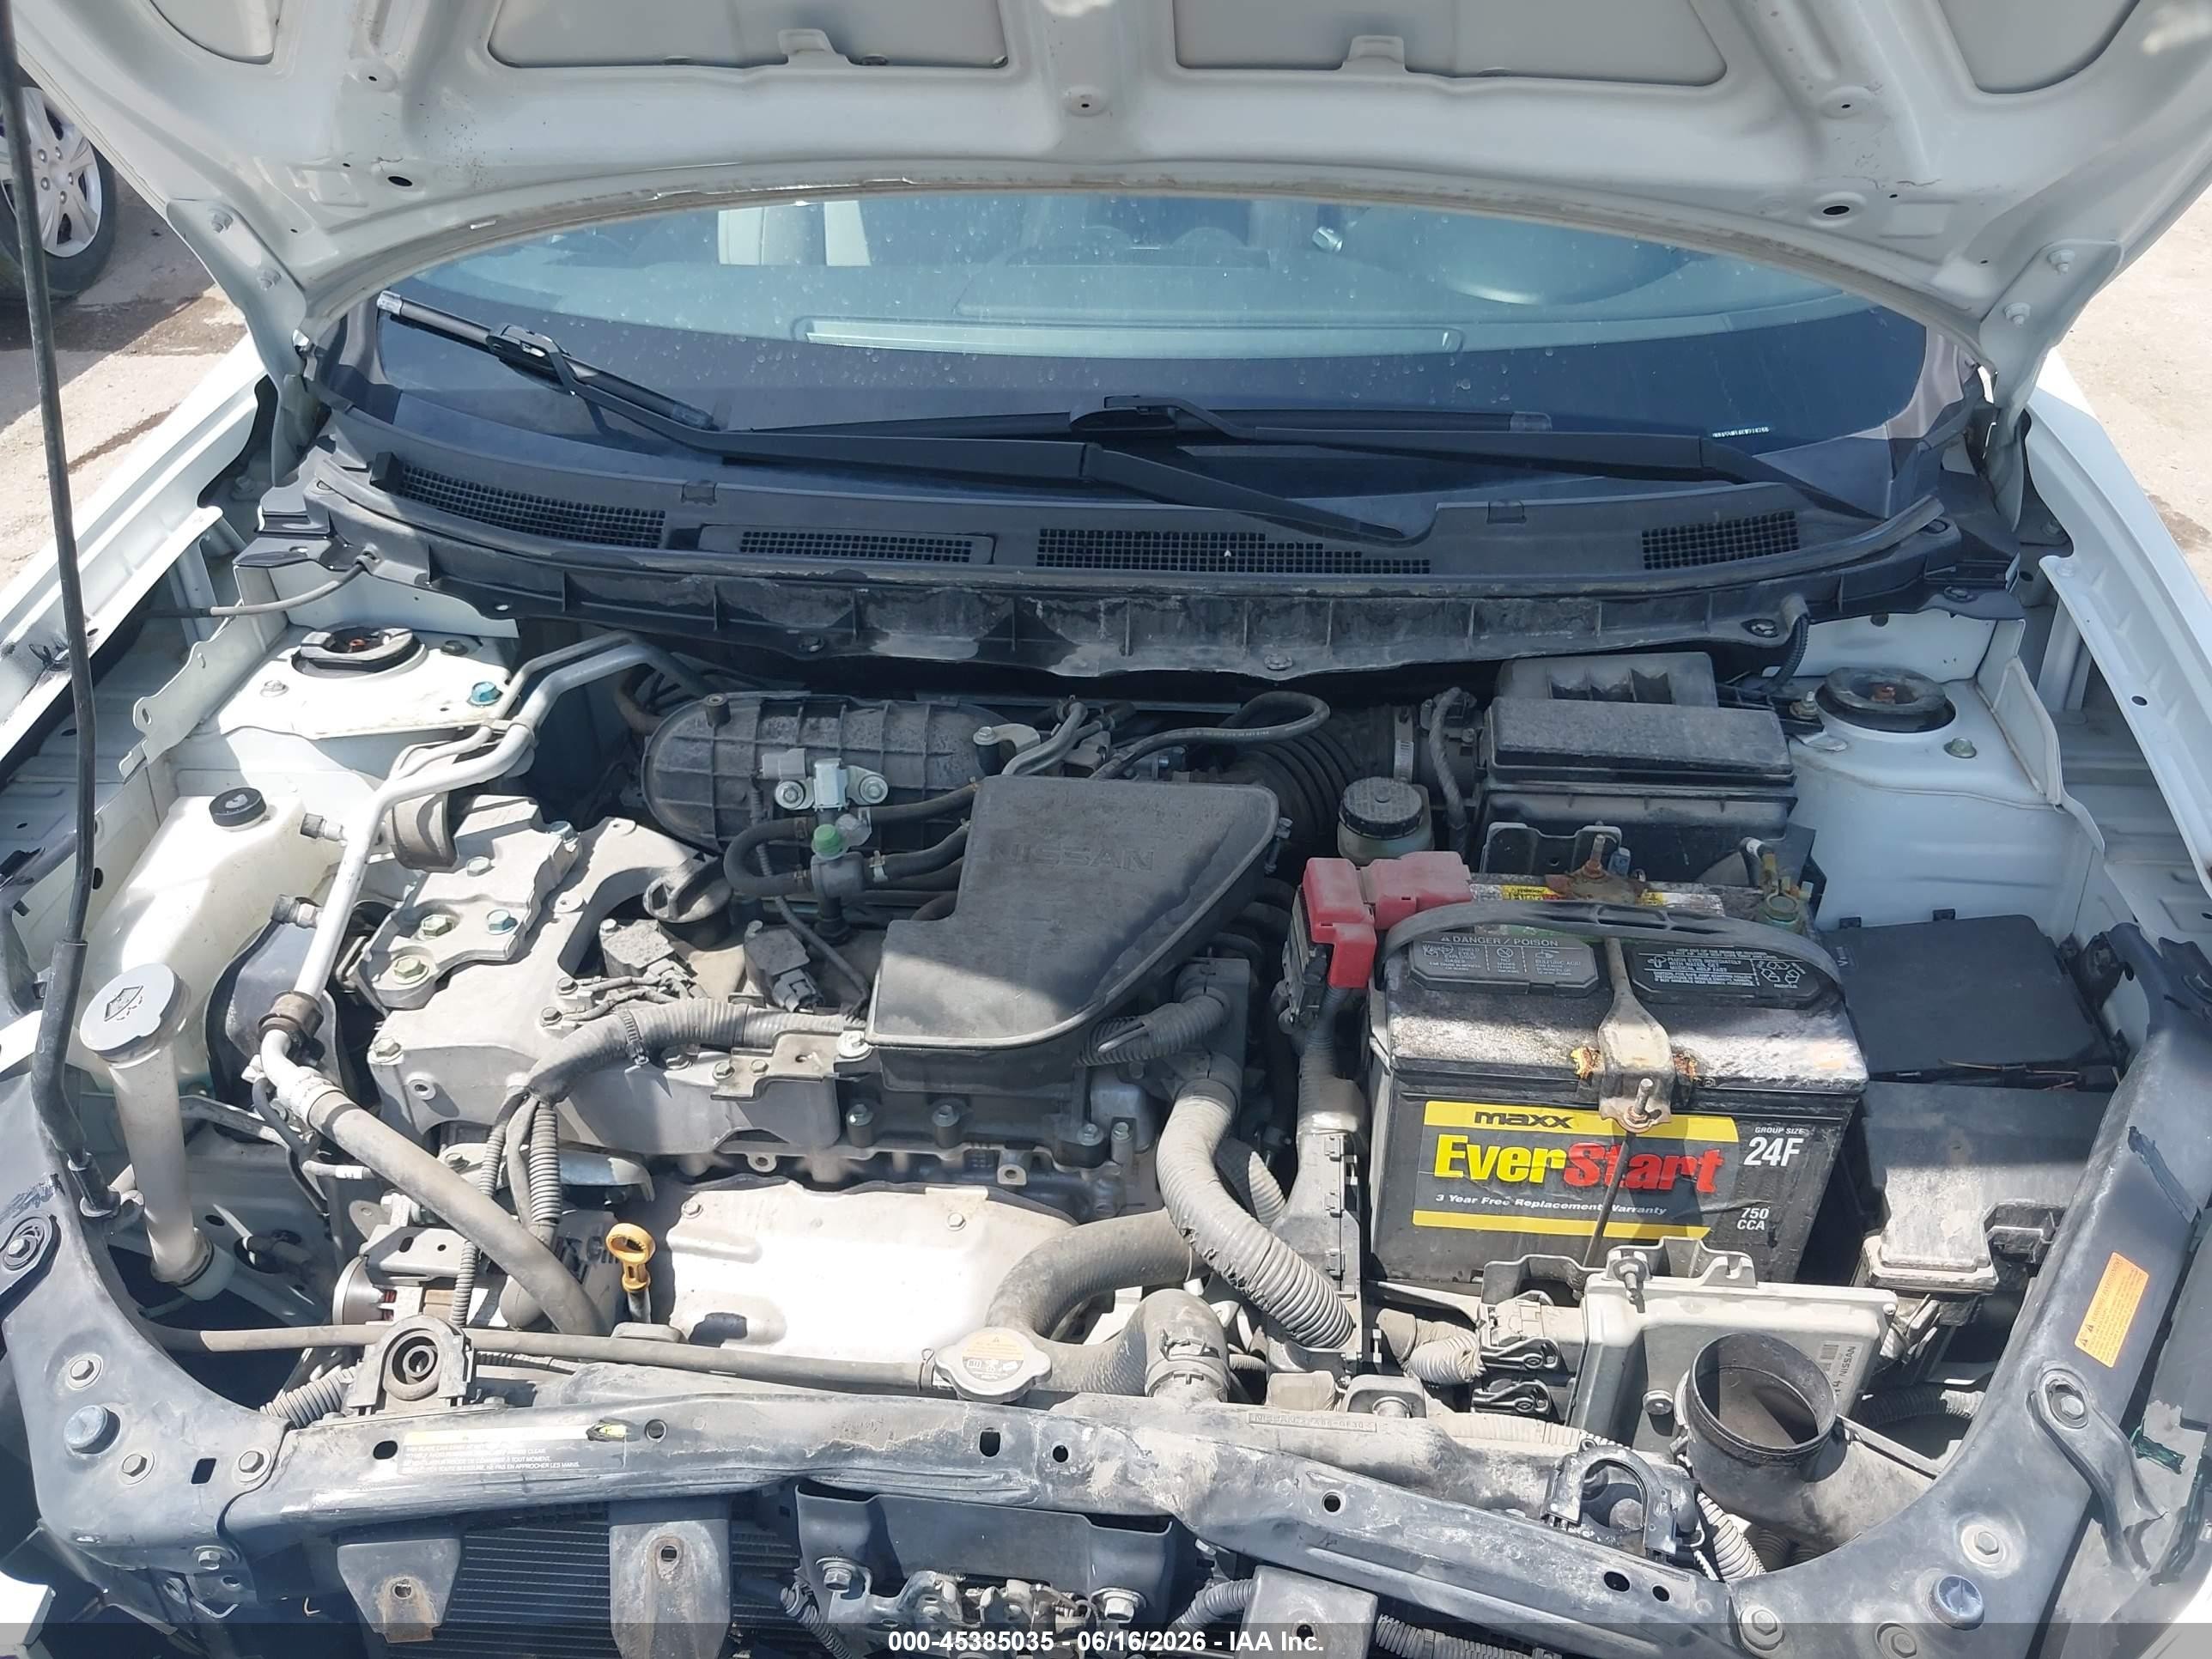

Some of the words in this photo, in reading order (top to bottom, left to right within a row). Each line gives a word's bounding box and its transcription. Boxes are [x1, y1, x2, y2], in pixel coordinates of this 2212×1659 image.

[989, 842, 1154, 872] NISSAN
[1452, 936, 1501, 945] DANGER
[1513, 938, 1559, 947] POISON
[1474, 1111, 1573, 1129] maxx
[1754, 1126, 1784, 1134] GROUP
[1743, 1136, 1804, 1167] 24F
[1435, 1193, 1444, 1202] 3
[1449, 1194, 1478, 1204] Year
[1480, 1196, 1510, 1206] Free
[1515, 1198, 1604, 1212] Replacement
[1741, 1207, 1770, 1219] 750
[1736, 1219, 1766, 1231] CCA
[1838, 1346, 1856, 1377] NISSAN
